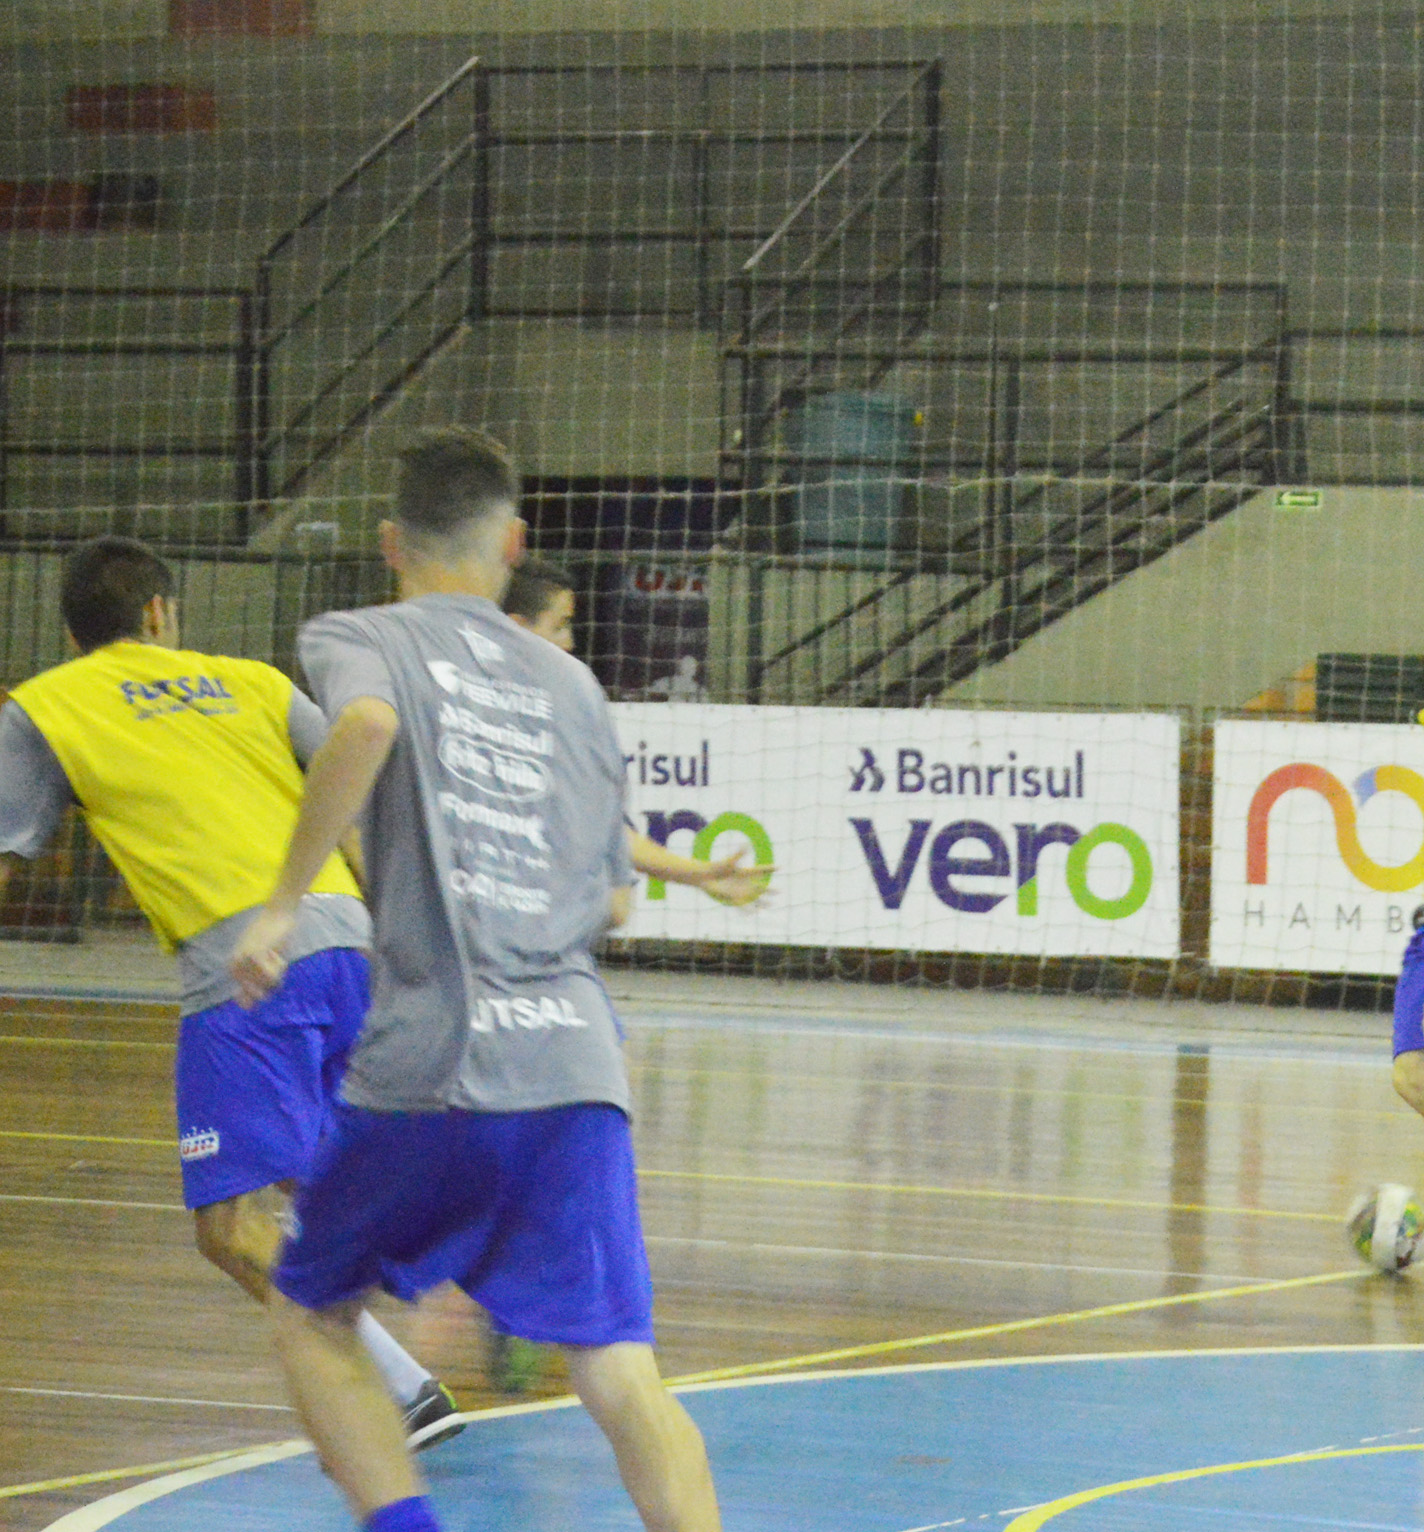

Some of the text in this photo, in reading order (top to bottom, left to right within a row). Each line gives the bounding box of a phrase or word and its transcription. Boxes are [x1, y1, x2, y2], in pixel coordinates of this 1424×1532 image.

[621, 740, 709, 787] risul
[897, 747, 1084, 798] Banrisul
[848, 817, 1153, 920] vero
[470, 996, 589, 1033] UTSAL
